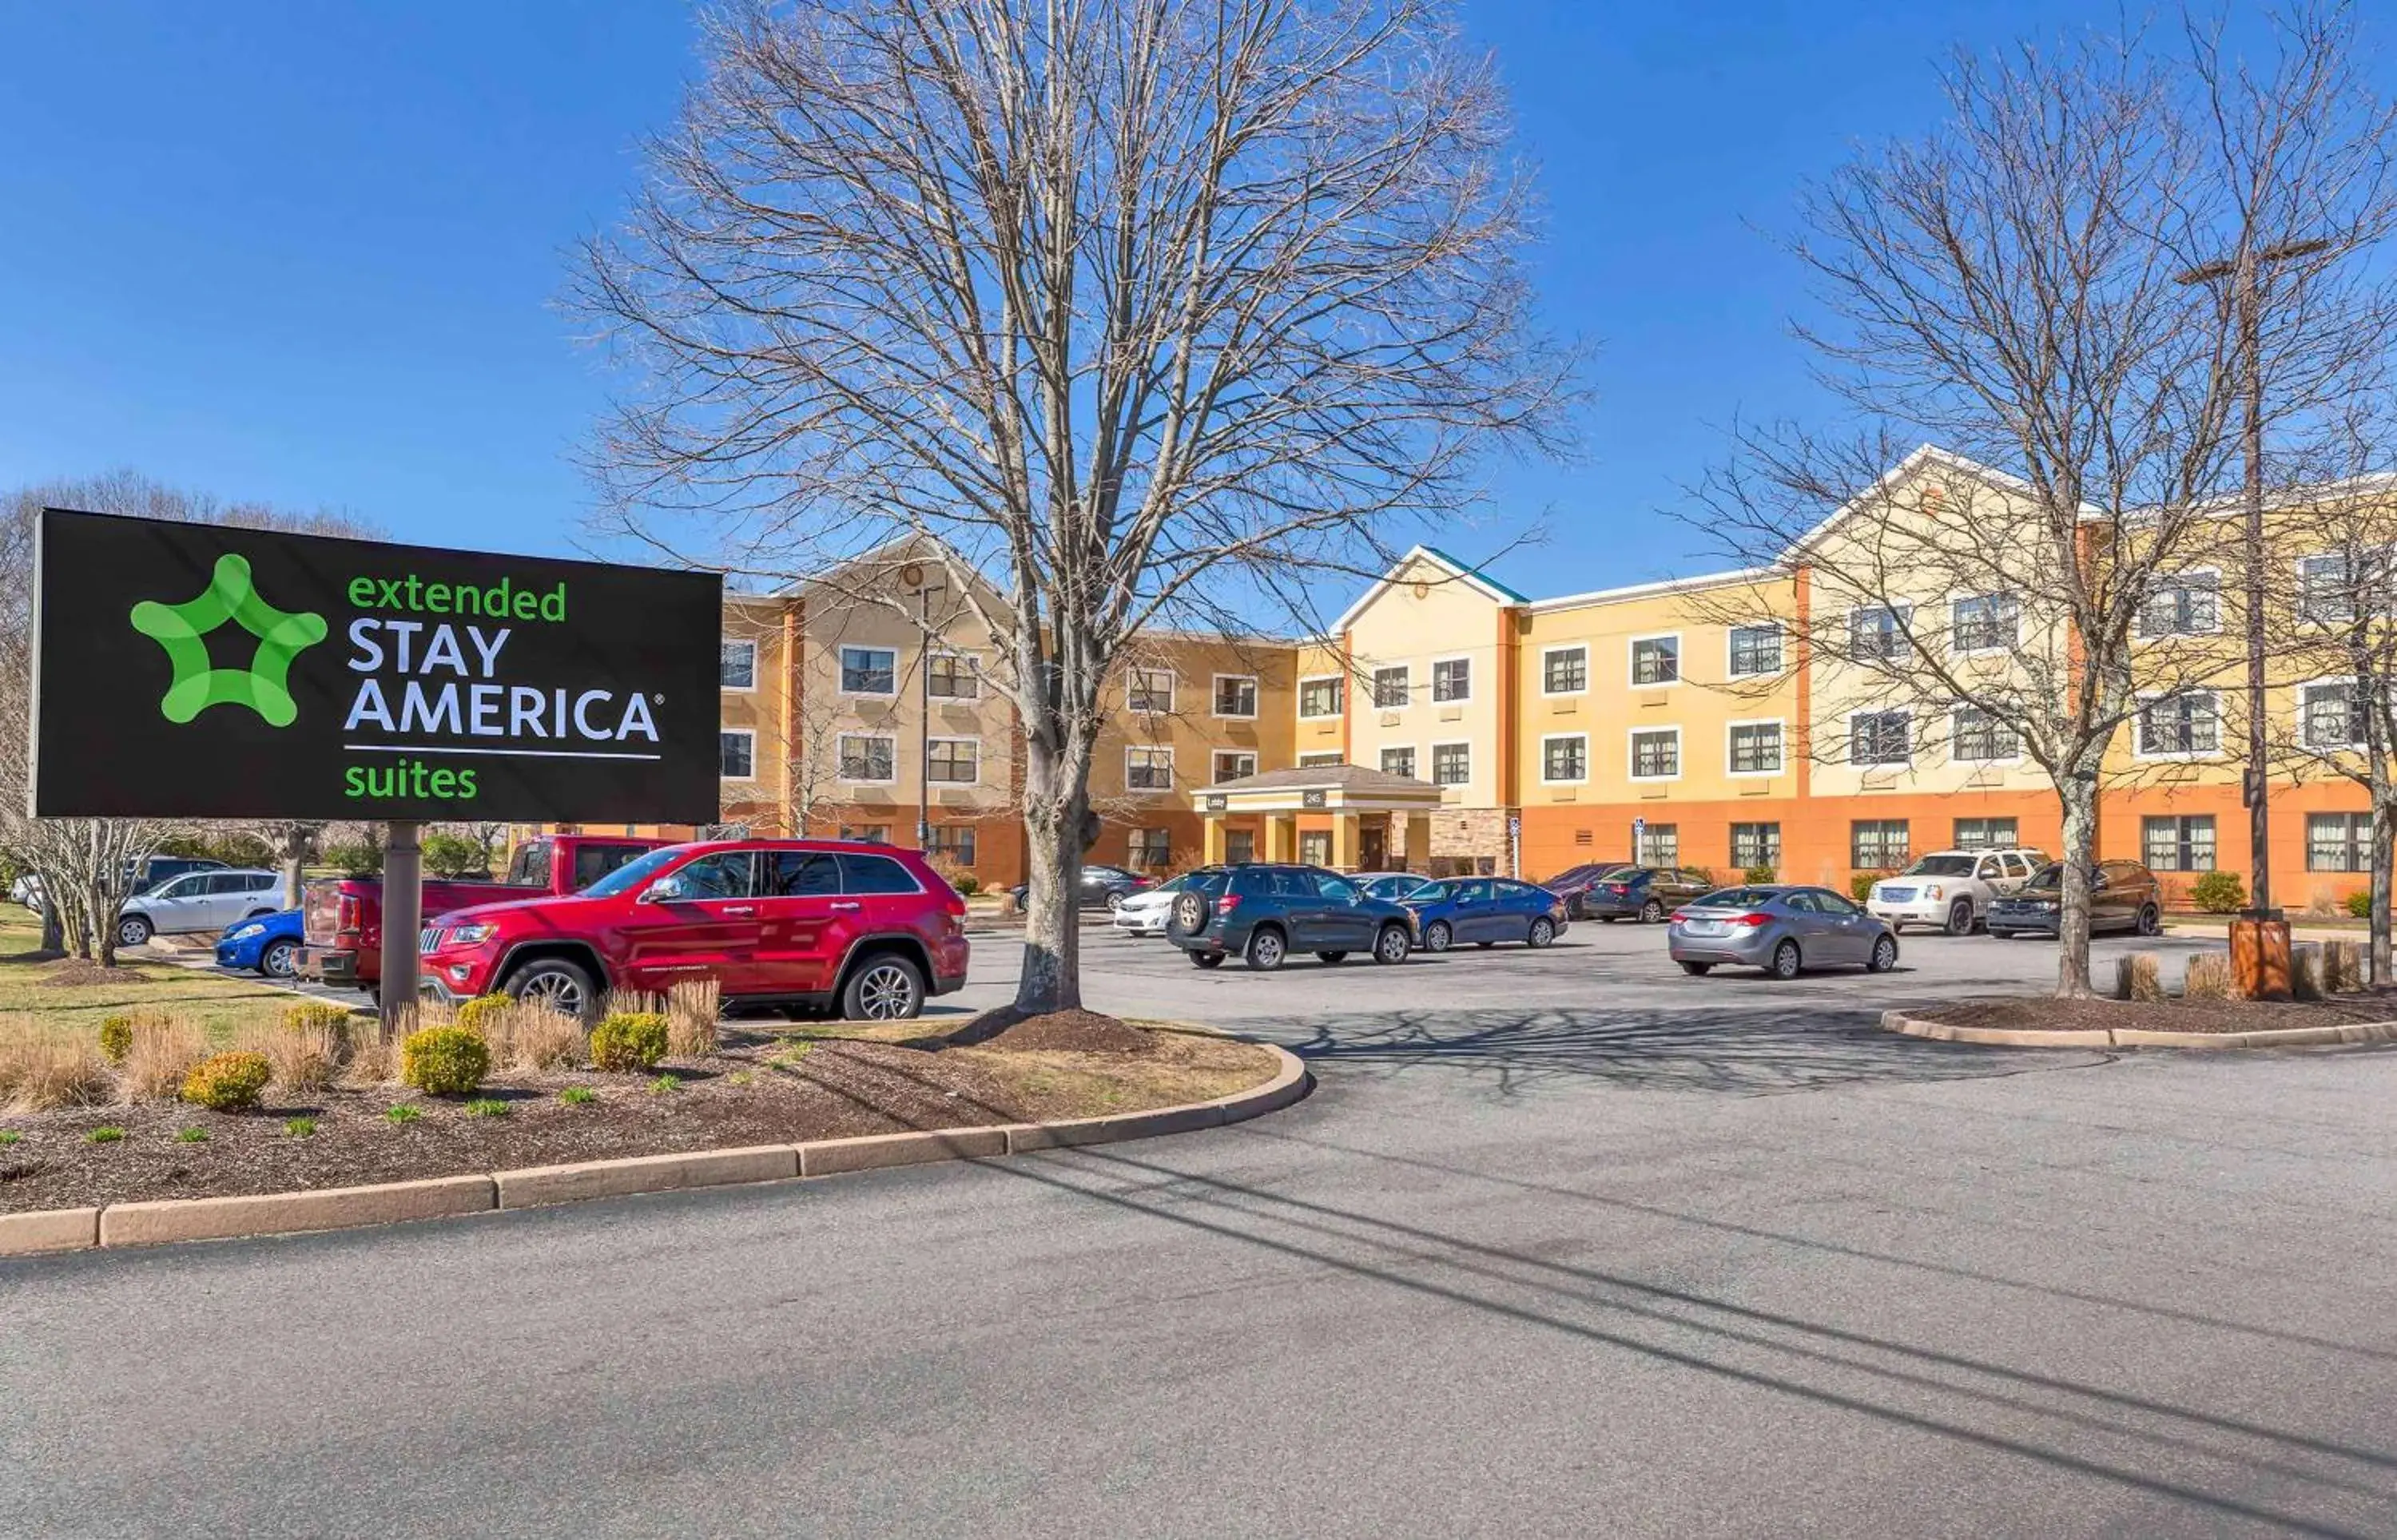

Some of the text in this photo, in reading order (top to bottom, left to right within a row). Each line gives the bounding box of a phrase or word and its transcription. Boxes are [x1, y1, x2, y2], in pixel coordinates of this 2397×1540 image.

[348, 574, 566, 622] extended
[348, 617, 511, 678] STAY
[344, 678, 660, 742] AMERICA
[344, 758, 479, 798] suites
